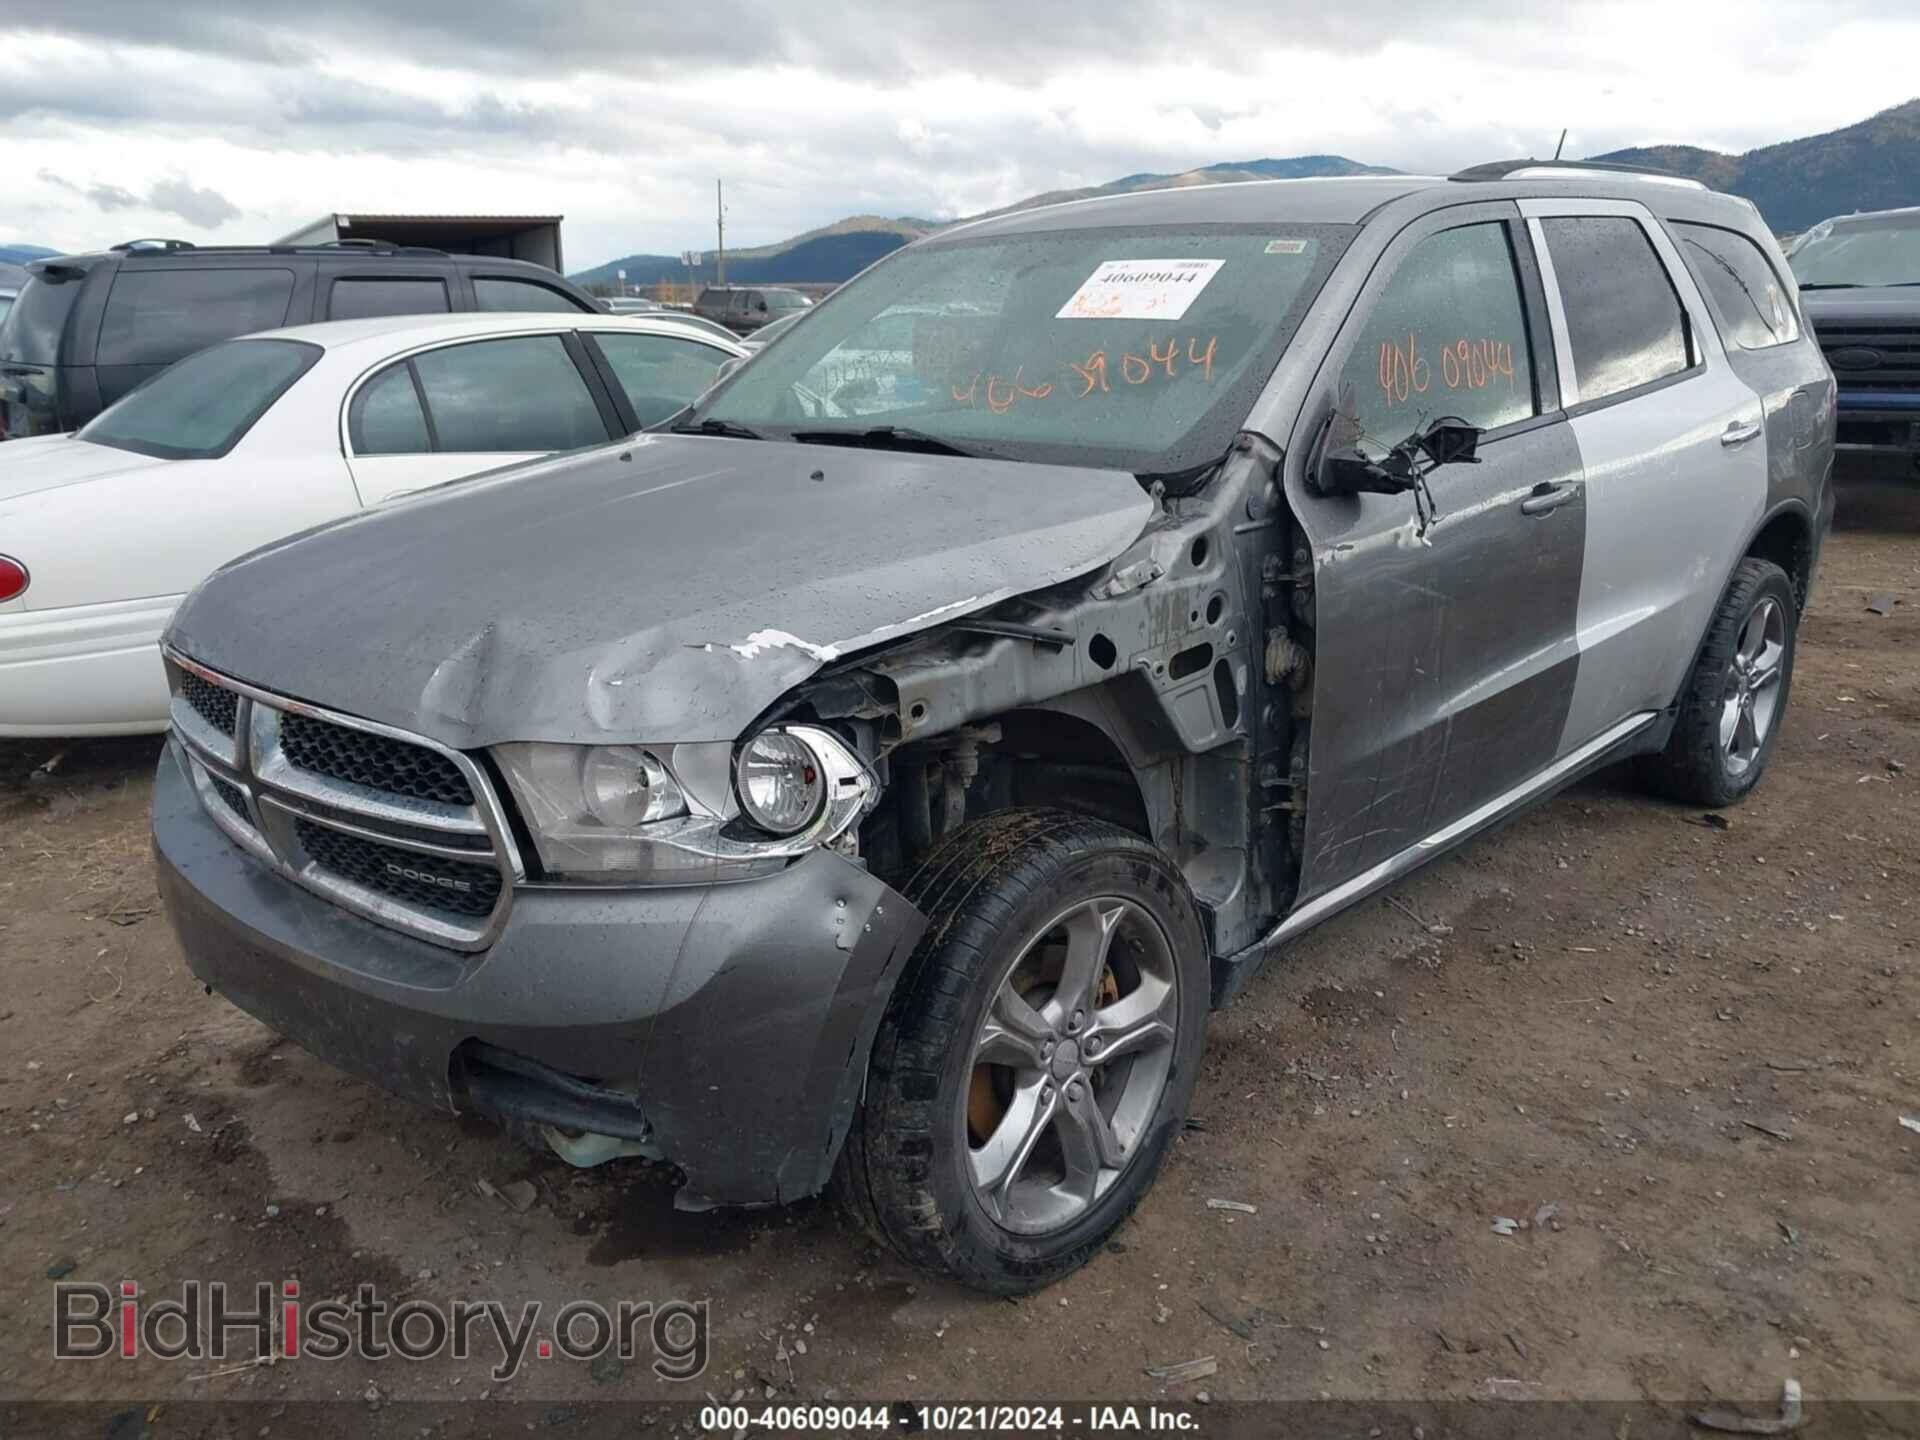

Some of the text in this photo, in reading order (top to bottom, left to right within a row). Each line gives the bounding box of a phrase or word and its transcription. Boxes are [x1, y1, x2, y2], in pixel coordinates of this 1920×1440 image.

[1101, 272, 1198, 283] 40609044
[1379, 334, 1515, 407] 406 09044
[386, 863, 472, 892] DODGE
